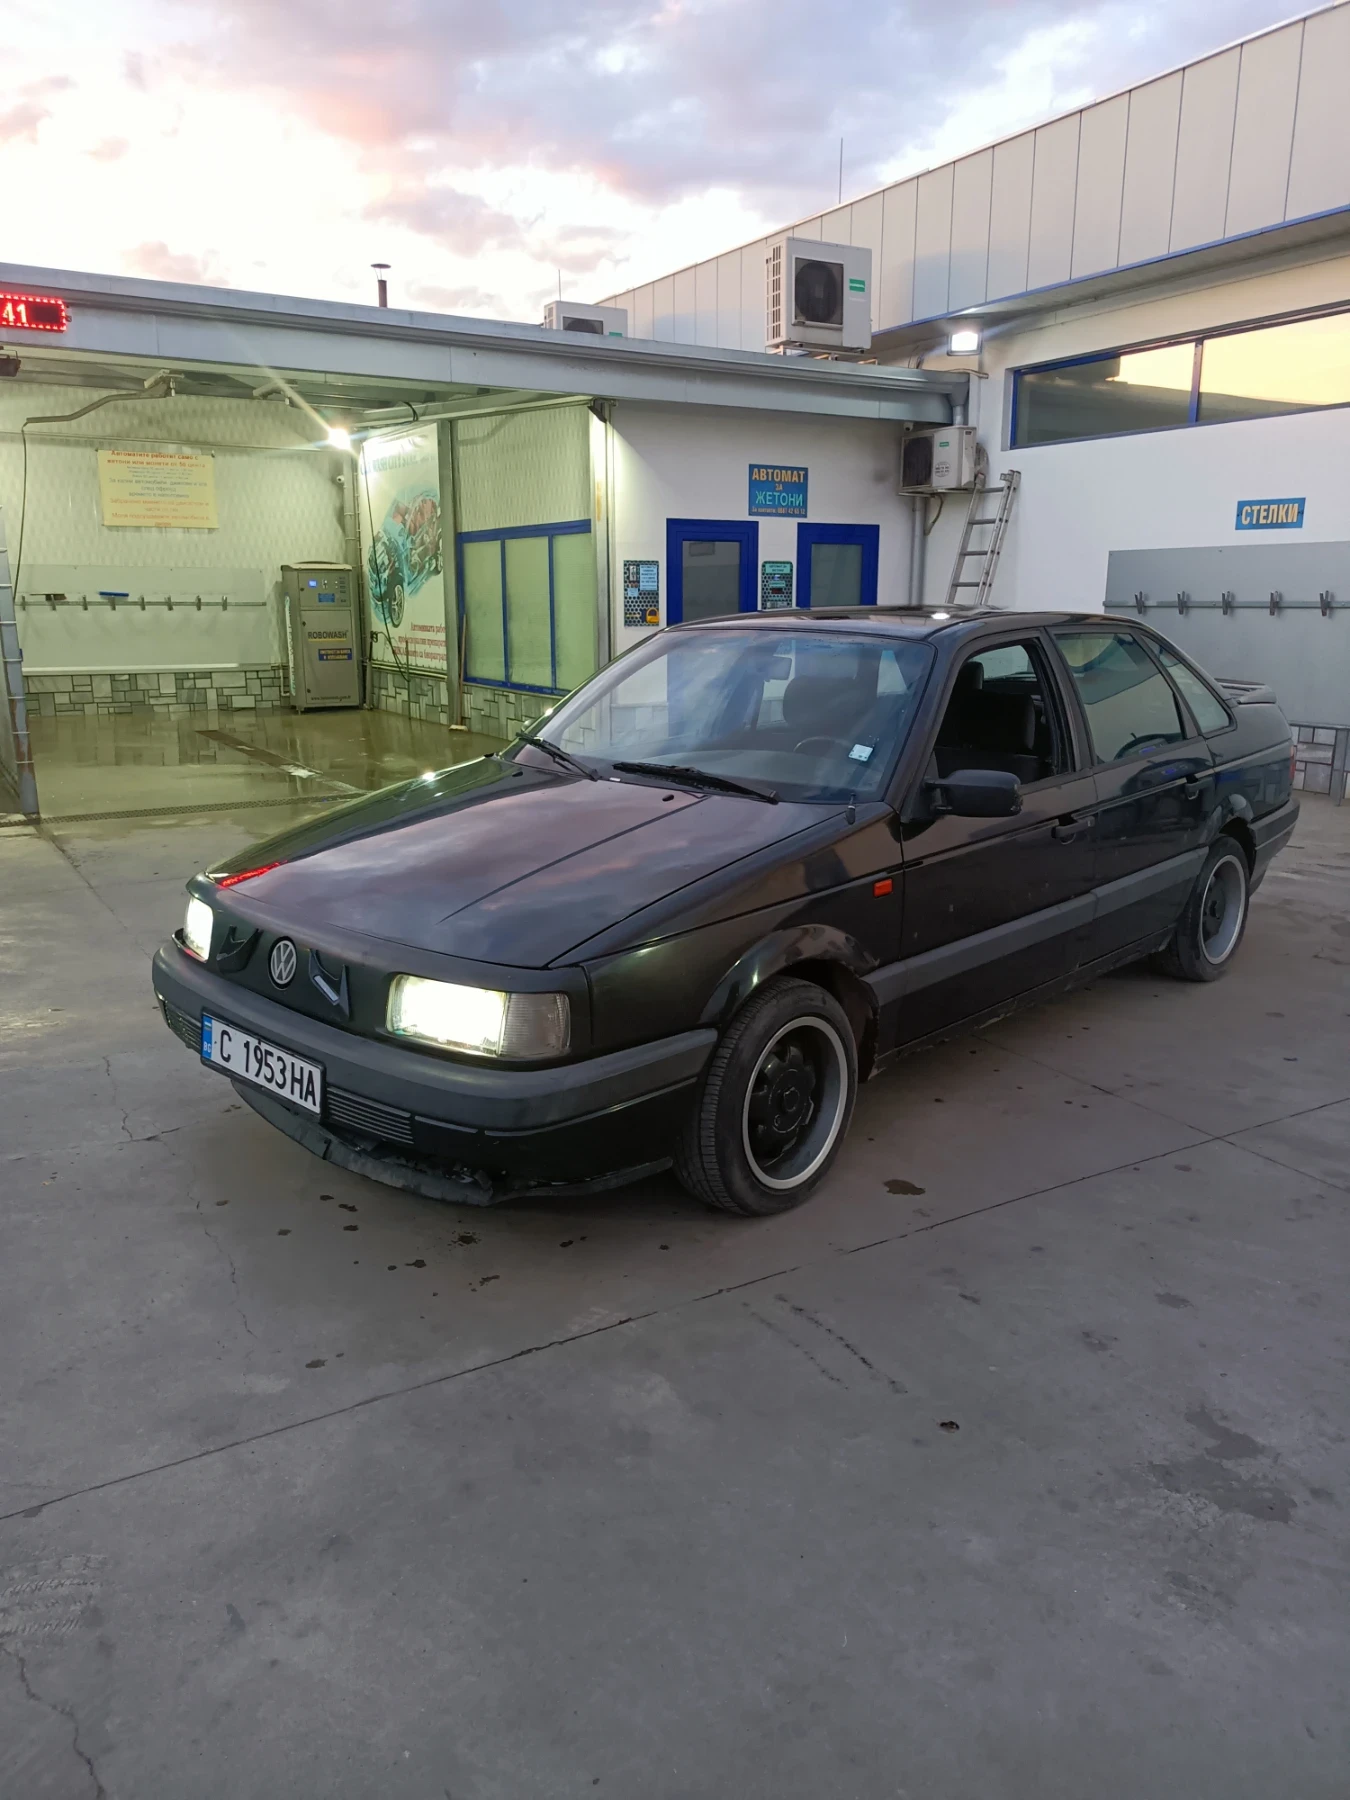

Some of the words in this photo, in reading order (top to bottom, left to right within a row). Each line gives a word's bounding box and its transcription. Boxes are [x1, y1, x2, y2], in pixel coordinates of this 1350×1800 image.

[2, 302, 27, 324] 41
[752, 468, 805, 483] АВТОМАТ
[755, 491, 803, 507] ЖЕТОНИ
[1241, 503, 1299, 525] СТЕЛКИ
[307, 631, 347, 639] ROBOWASH
[435, 622, 446, 635] рабо
[203, 1042, 212, 1053] BG
[220, 1029, 232, 1063] C
